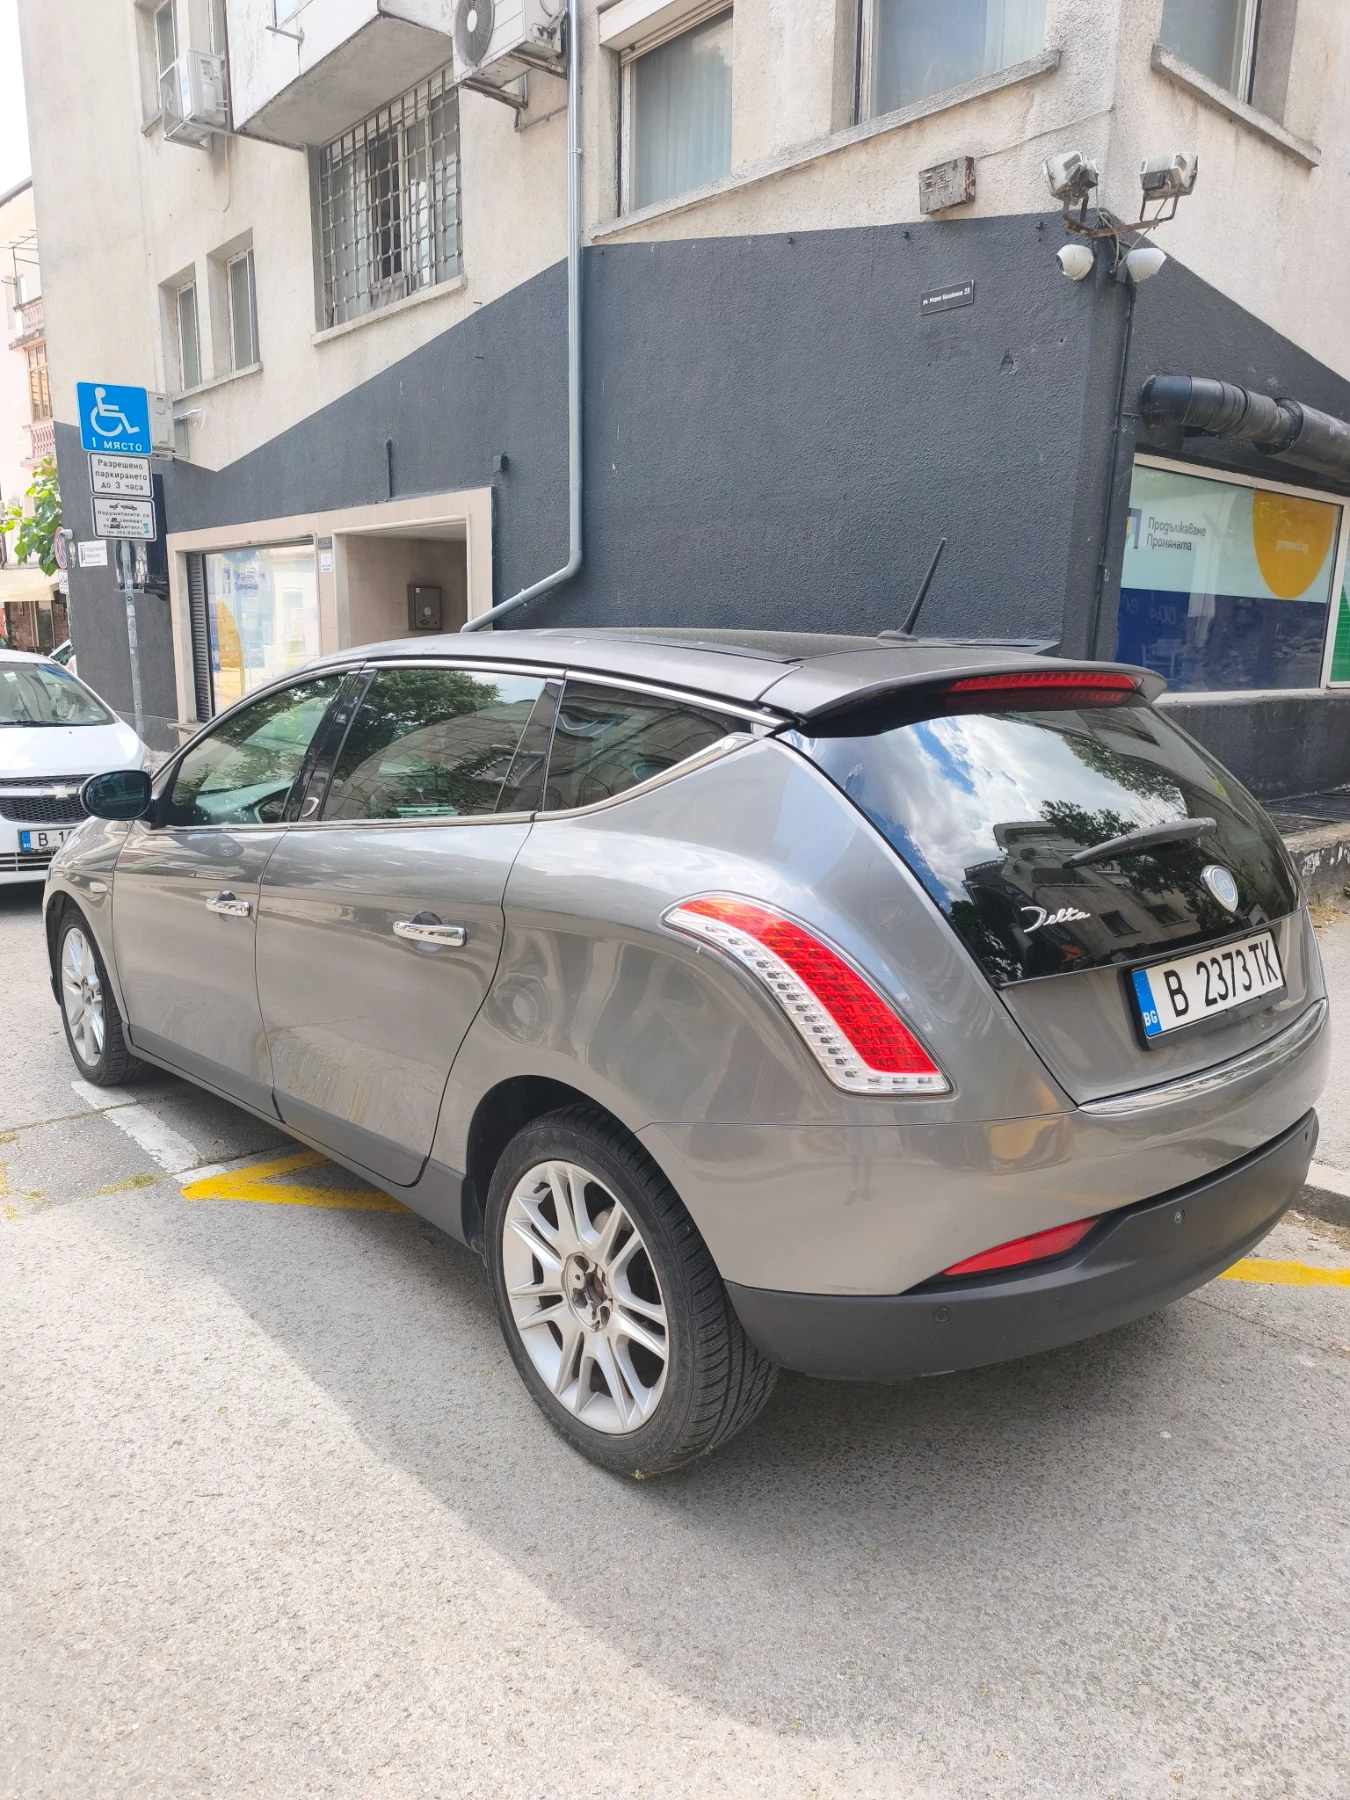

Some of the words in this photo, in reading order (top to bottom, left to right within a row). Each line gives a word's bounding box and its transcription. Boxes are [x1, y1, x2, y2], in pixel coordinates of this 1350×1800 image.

[92, 437, 96, 448] 1
[98, 459, 143, 470] Разрешено
[95, 471, 148, 480] паркирането
[1148, 517, 1206, 536] Продължаваме
[1146, 533, 1192, 550] Промяната
[38, 832, 48, 846] B
[1020, 906, 1091, 933] Delta
[1163, 969, 1189, 1017] B
[1196, 950, 1252, 1007] 2373
[1248, 940, 1278, 986] TK
[1143, 1012, 1158, 1026] BG
